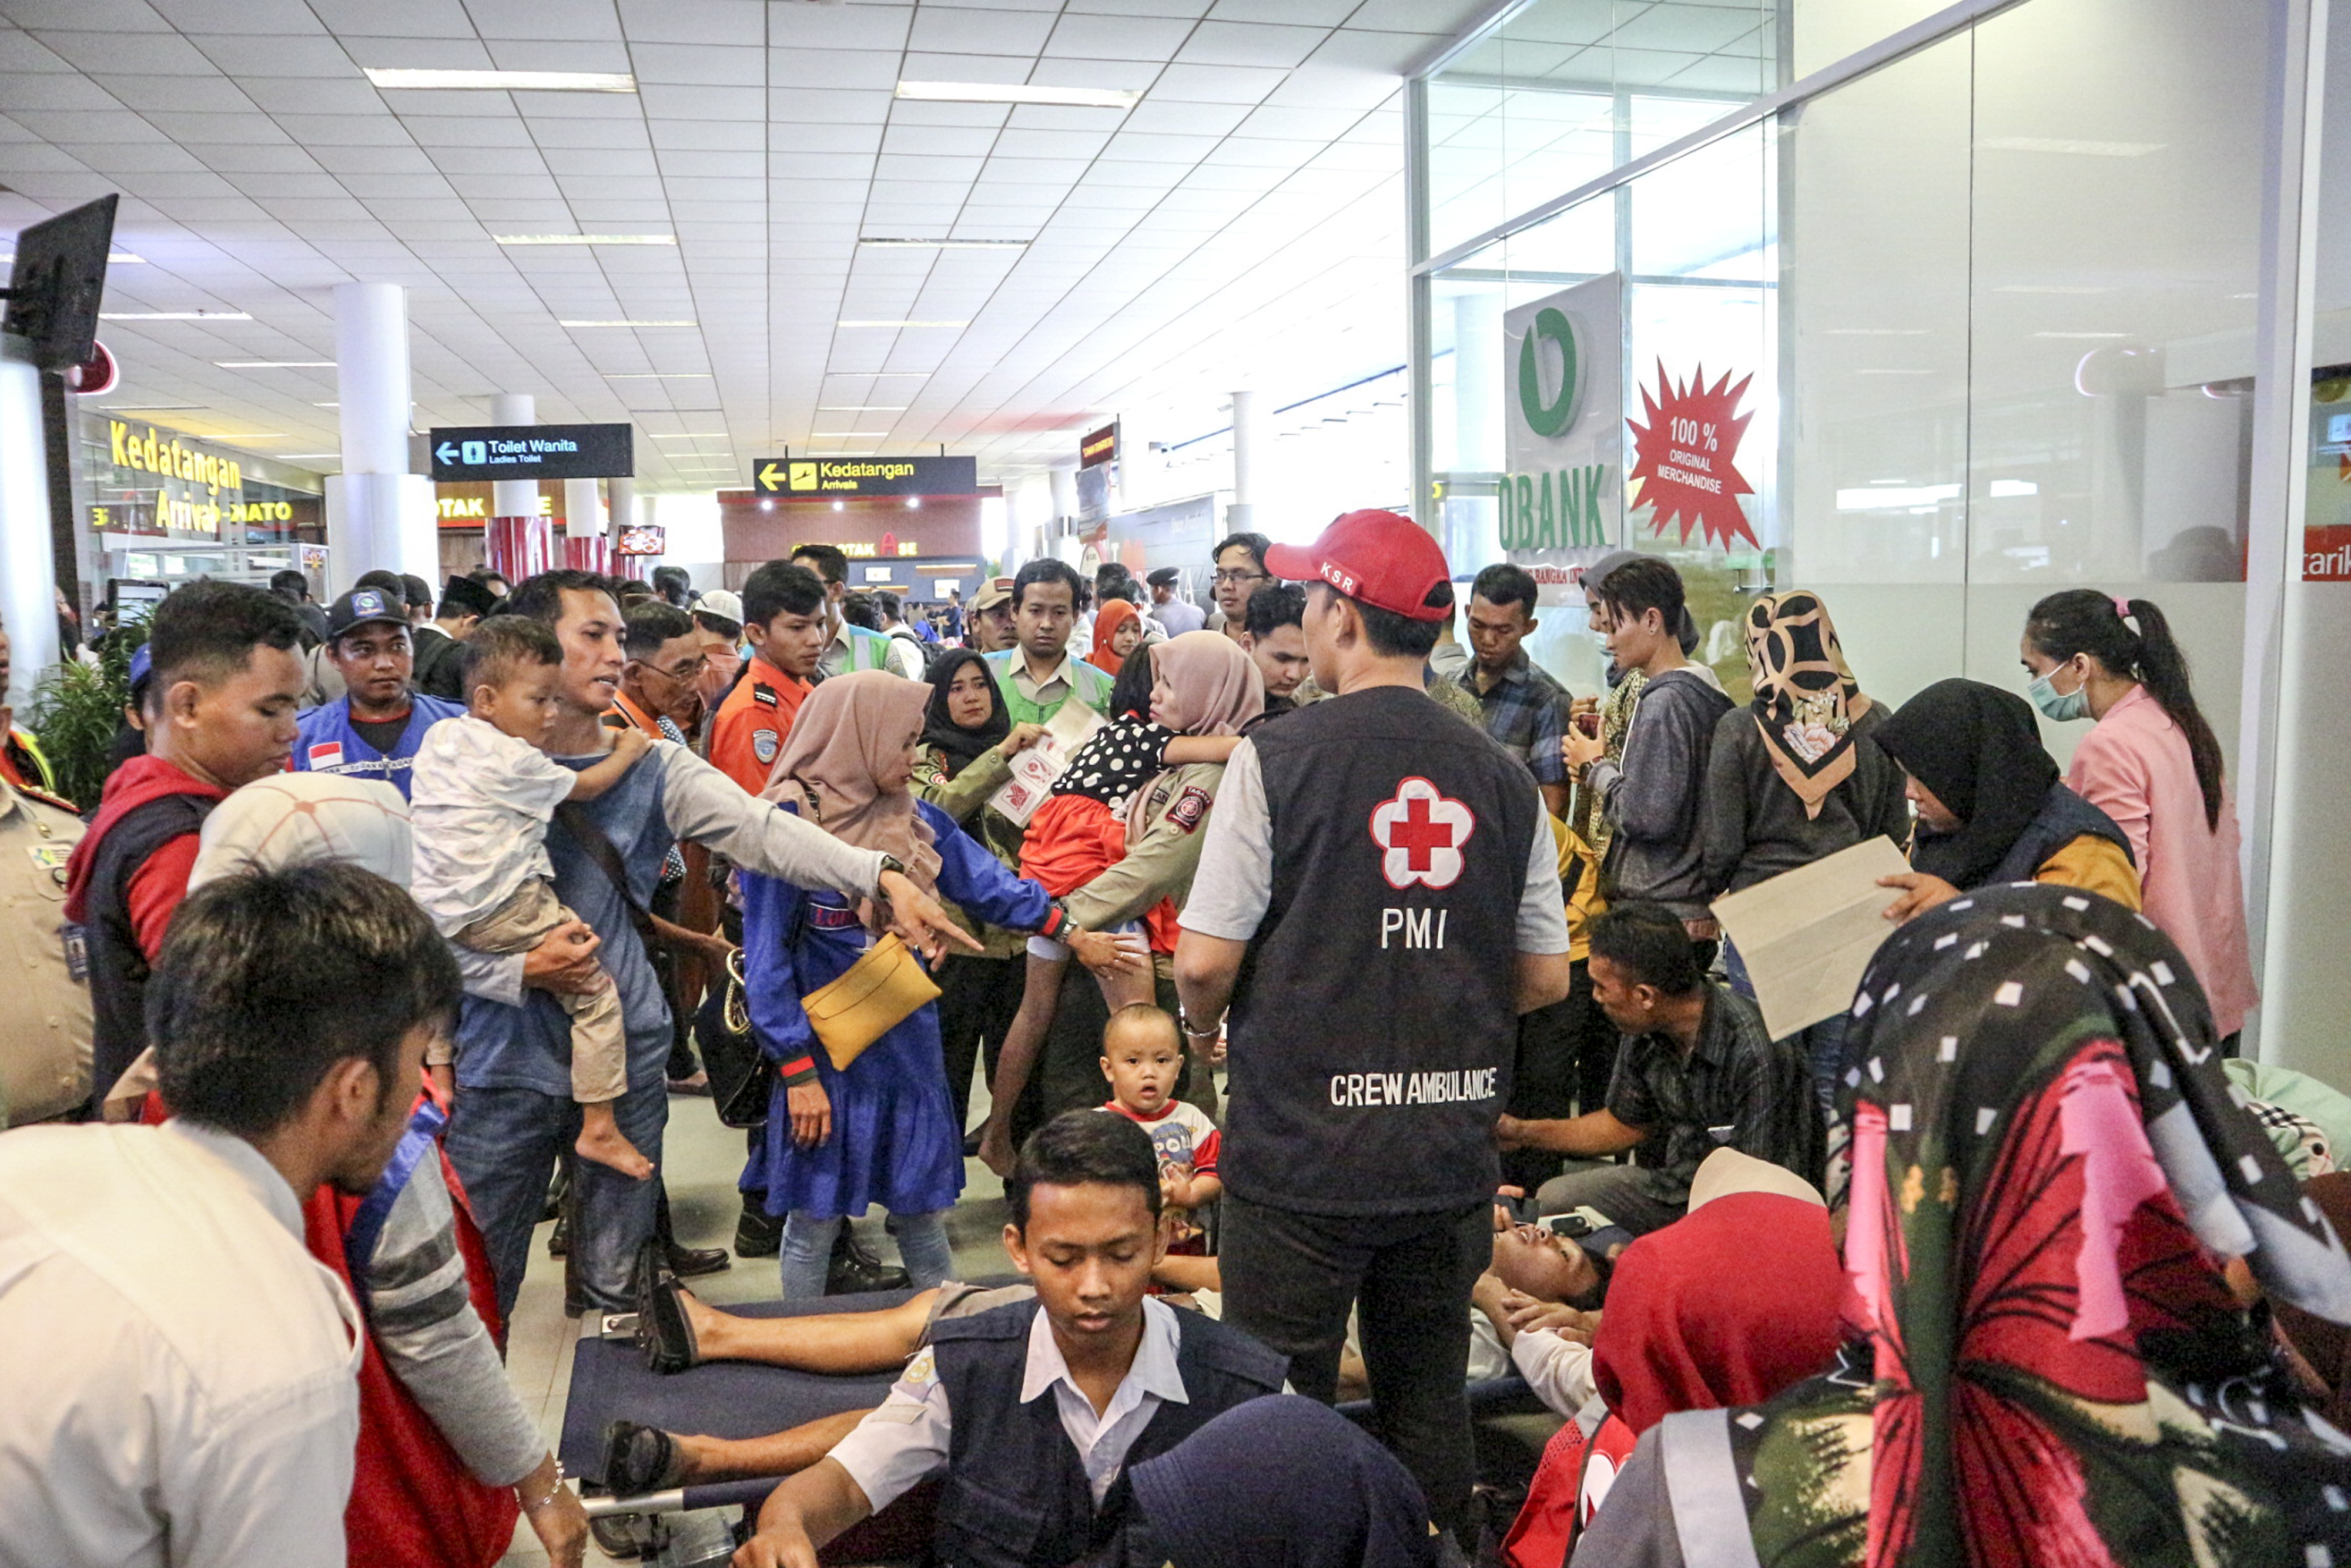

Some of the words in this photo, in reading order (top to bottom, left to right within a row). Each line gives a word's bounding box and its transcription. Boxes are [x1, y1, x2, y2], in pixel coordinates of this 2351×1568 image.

[488, 440, 527, 454] Toilet
[529, 439, 577, 453] Wanita
[1670, 416, 1698, 446] 100
[1703, 423, 1717, 452] %
[110, 420, 242, 496] Kedatangan
[489, 455, 517, 464] Ladies
[519, 454, 542, 463] Toilet
[820, 463, 915, 480] Kedatangan
[1670, 449, 1713, 473] ORIGINAL
[822, 480, 858, 490] Arrivals
[1657, 464, 1722, 495] MERCHANDISE
[1499, 463, 1606, 551] OBANK
[1320, 562, 1353, 592] KSR
[1535, 568, 1567, 584] BANGKA
[1381, 907, 1448, 949] PMI
[1330, 1073, 1404, 1107] CREW
[1406, 1067, 1498, 1105] AMBULANCE
